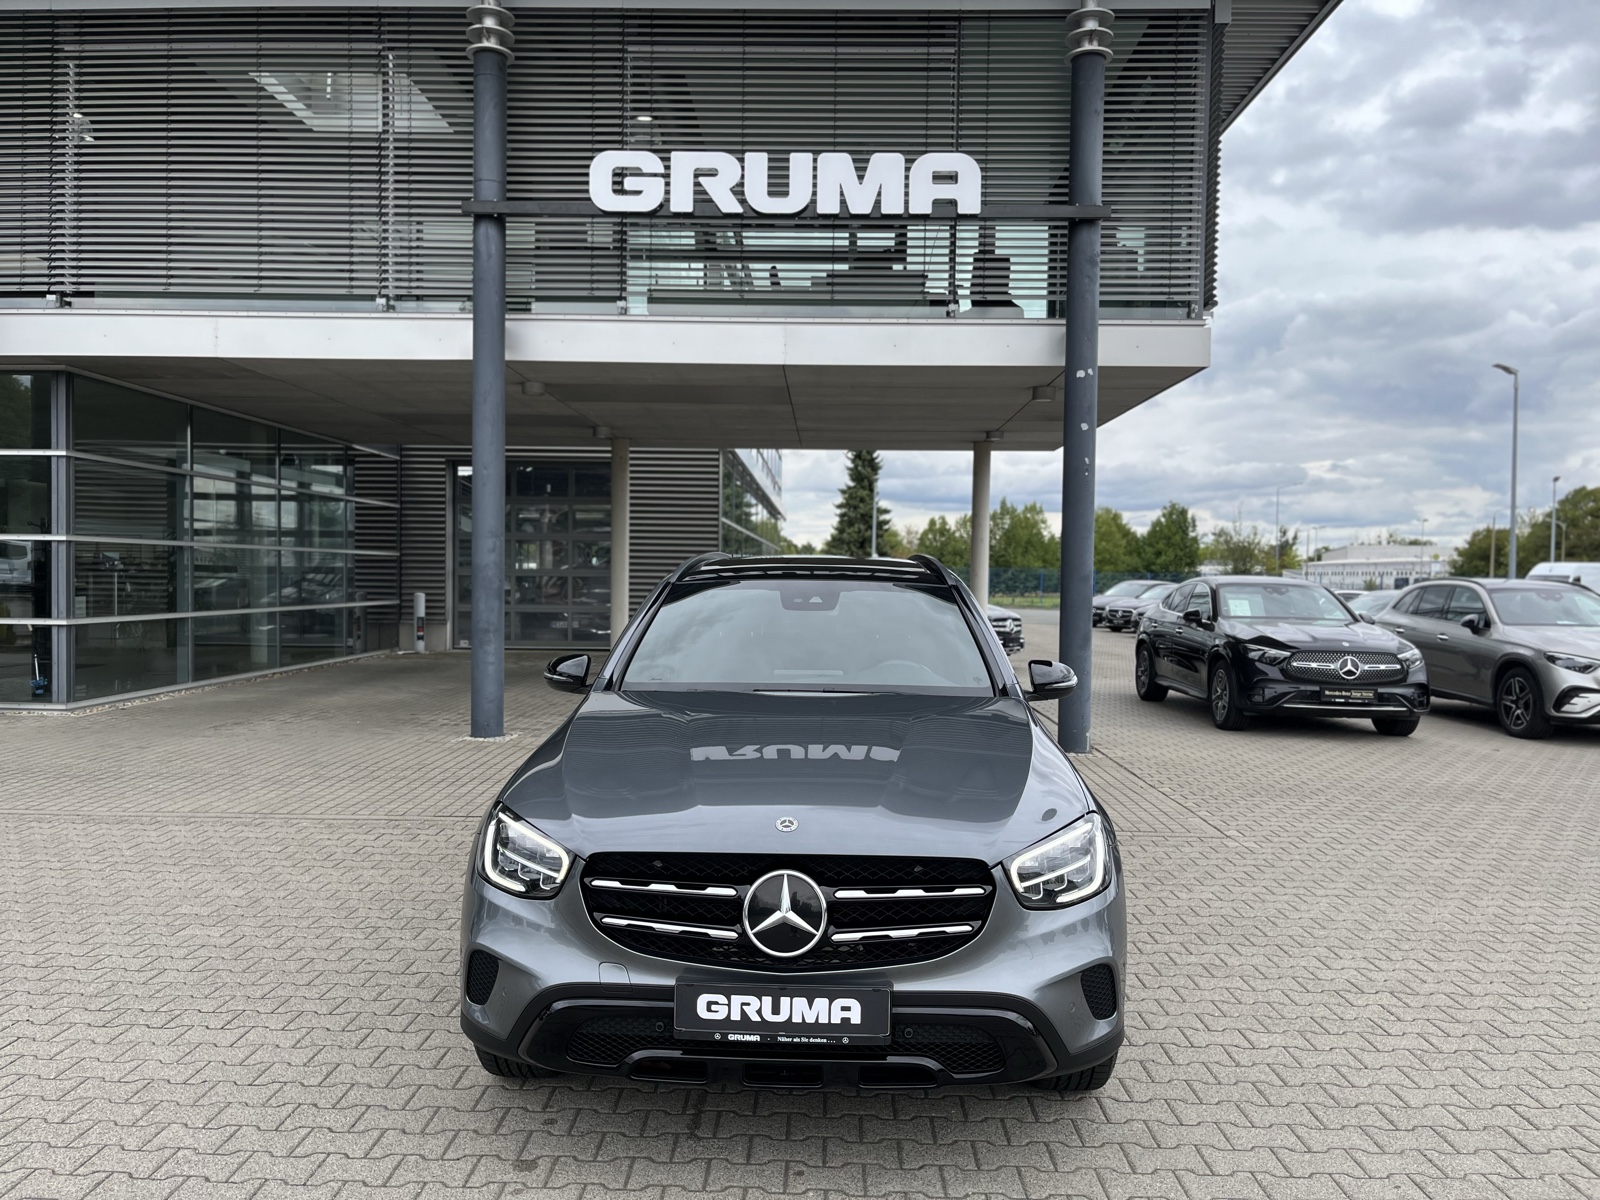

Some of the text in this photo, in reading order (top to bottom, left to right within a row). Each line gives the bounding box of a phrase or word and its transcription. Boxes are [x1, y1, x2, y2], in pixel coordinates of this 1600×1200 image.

[589, 150, 982, 215] GRUMA
[696, 993, 861, 1024] GRUMA
[728, 1033, 760, 1042] GRUMA
